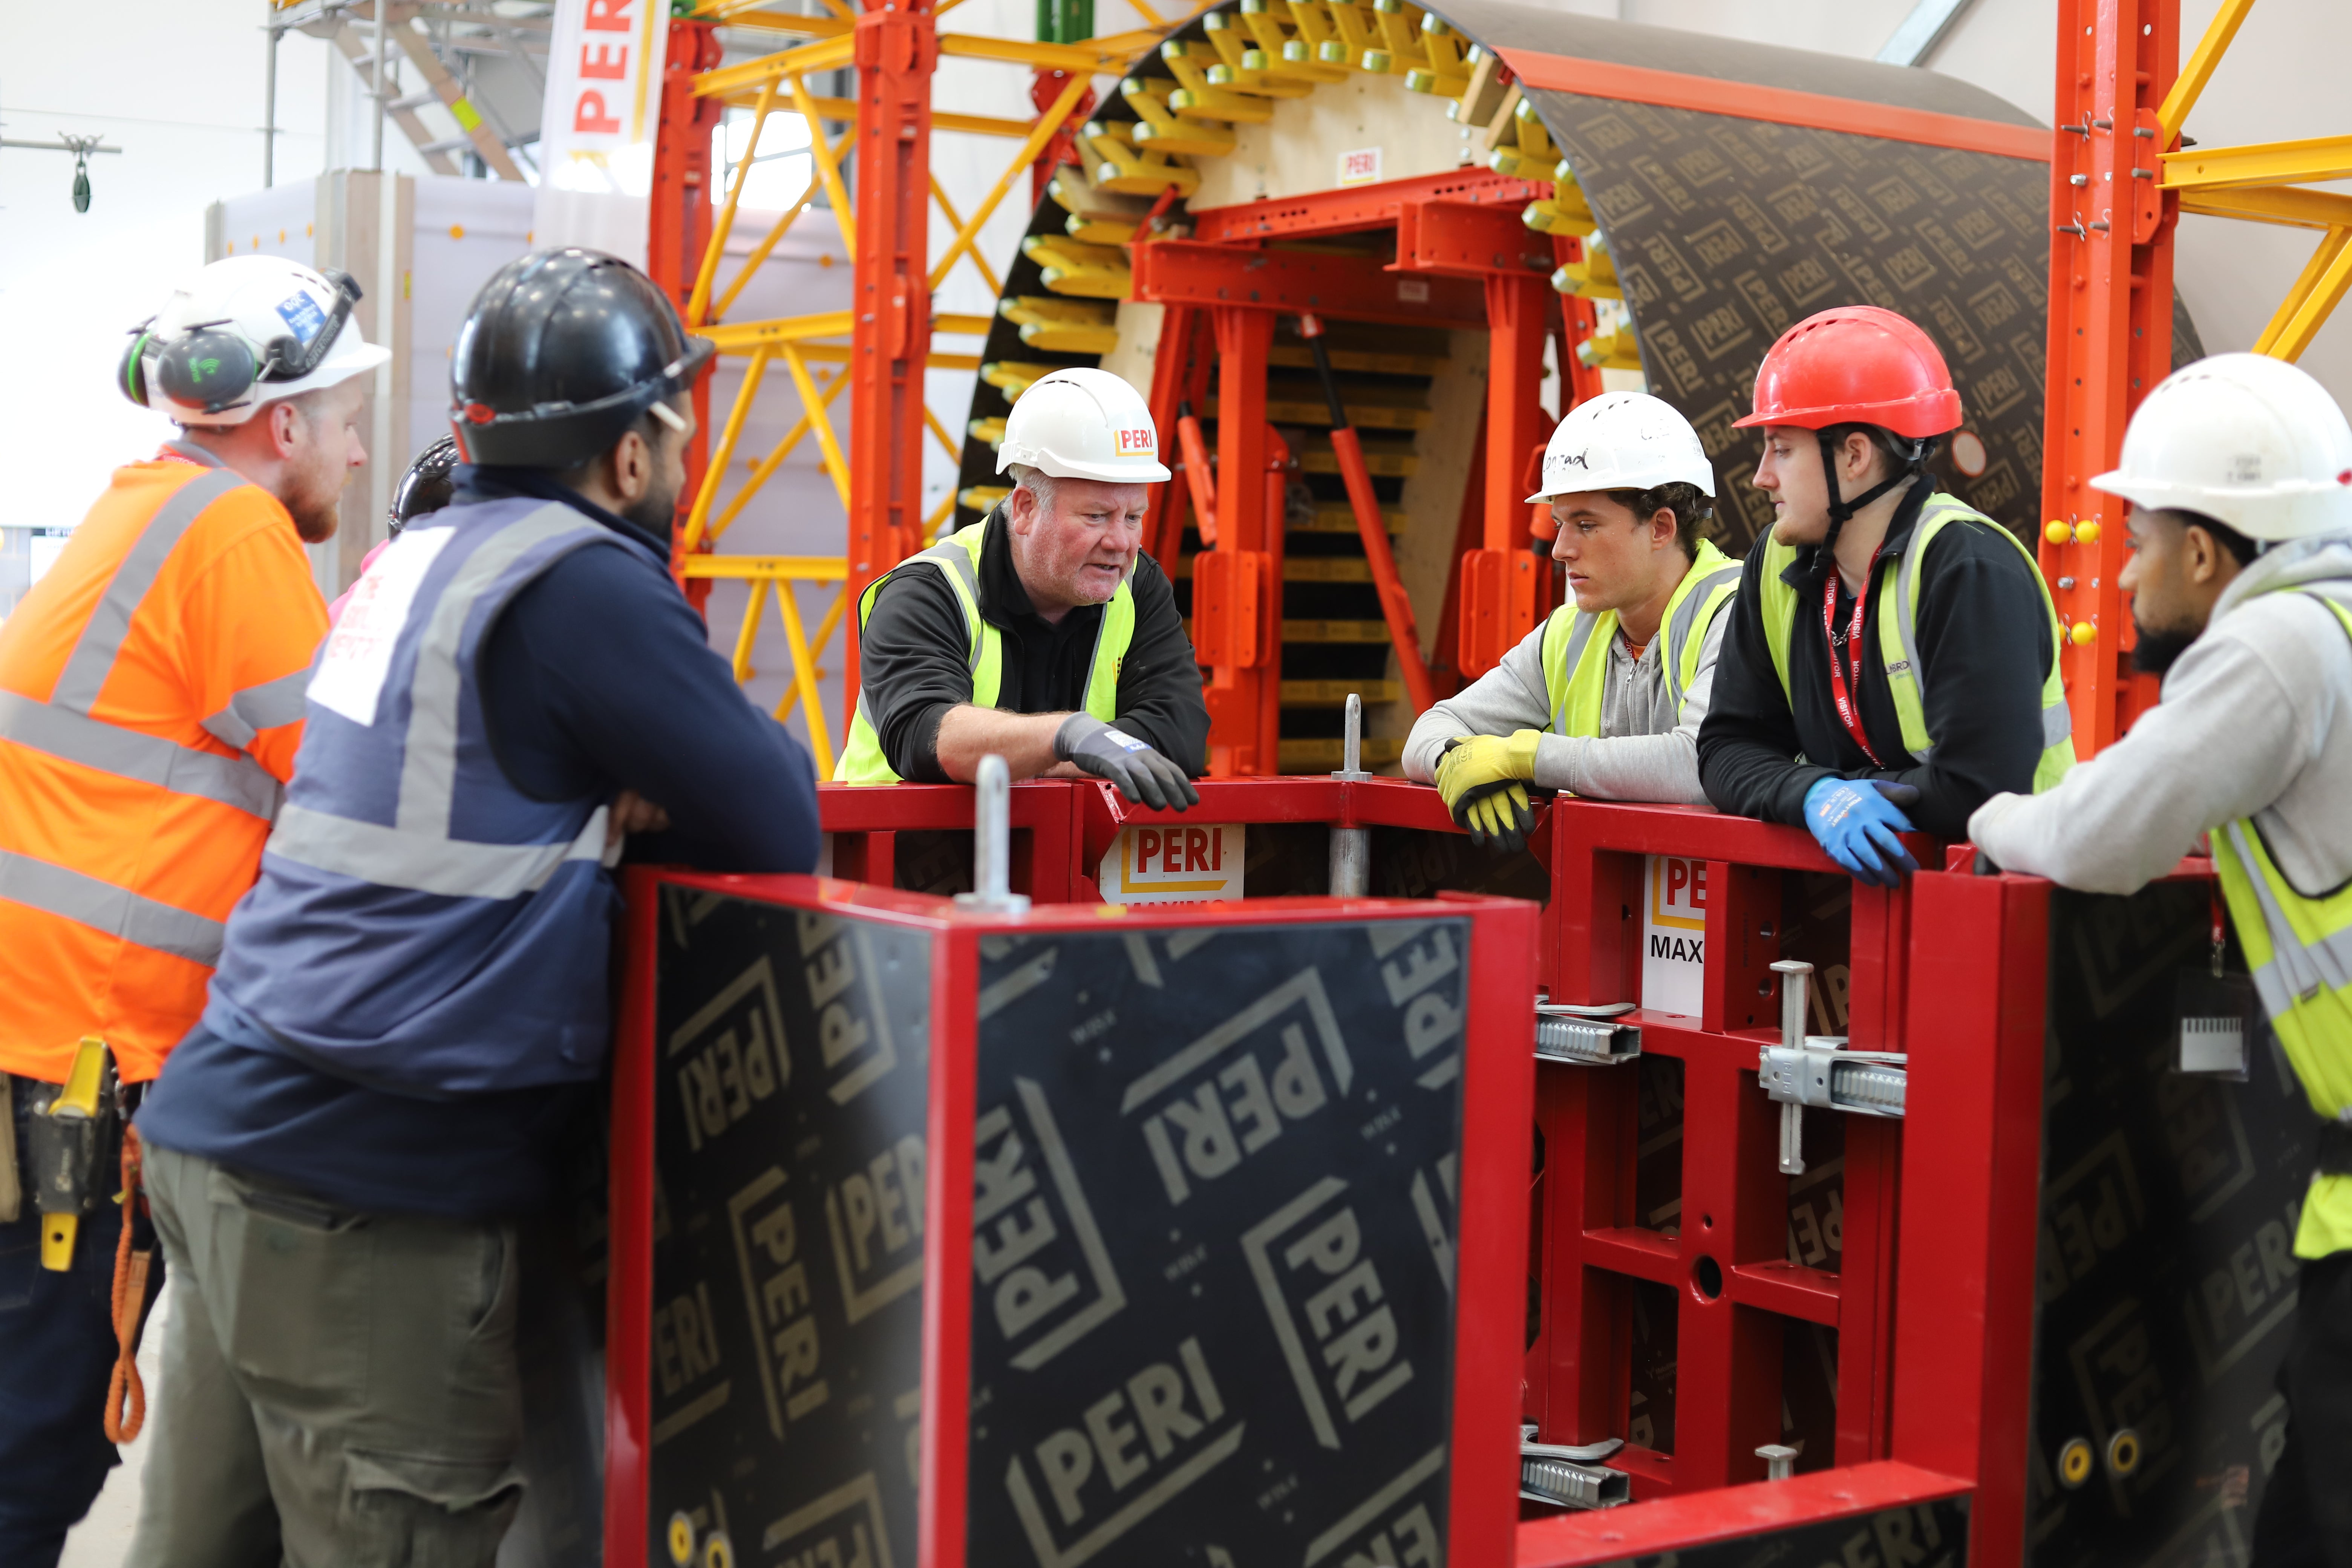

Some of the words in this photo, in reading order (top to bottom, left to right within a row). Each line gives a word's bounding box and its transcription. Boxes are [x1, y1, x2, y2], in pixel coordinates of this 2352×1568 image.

[574, 0, 633, 133] PER
[1346, 153, 1376, 175] PERI
[1642, 236, 1693, 292] PERI
[1694, 302, 1746, 347] PERI
[1657, 329, 1705, 393] PERI
[1977, 364, 2020, 406] PERI
[1121, 429, 1152, 449] PERI
[1827, 577, 1836, 605] VISITOR
[1852, 606, 1862, 640] VISITOR
[1838, 697, 1854, 728] VISITOR
[1862, 745, 1881, 767] VISITO
[1832, 796, 1863, 827] PORTWEST
[1138, 828, 1222, 873] PERI
[1667, 858, 1706, 909] PE
[1651, 935, 1703, 963] MAX
[795, 911, 868, 1070] PER
[678, 1006, 775, 1152] PERI
[1142, 1021, 1328, 1207] PERI
[841, 1132, 927, 1273] PER
[752, 1201, 828, 1423] PERI
[1285, 1206, 1415, 1424] PERI
[651, 1280, 720, 1398] ERI
[1035, 1335, 1225, 1527] PERI
